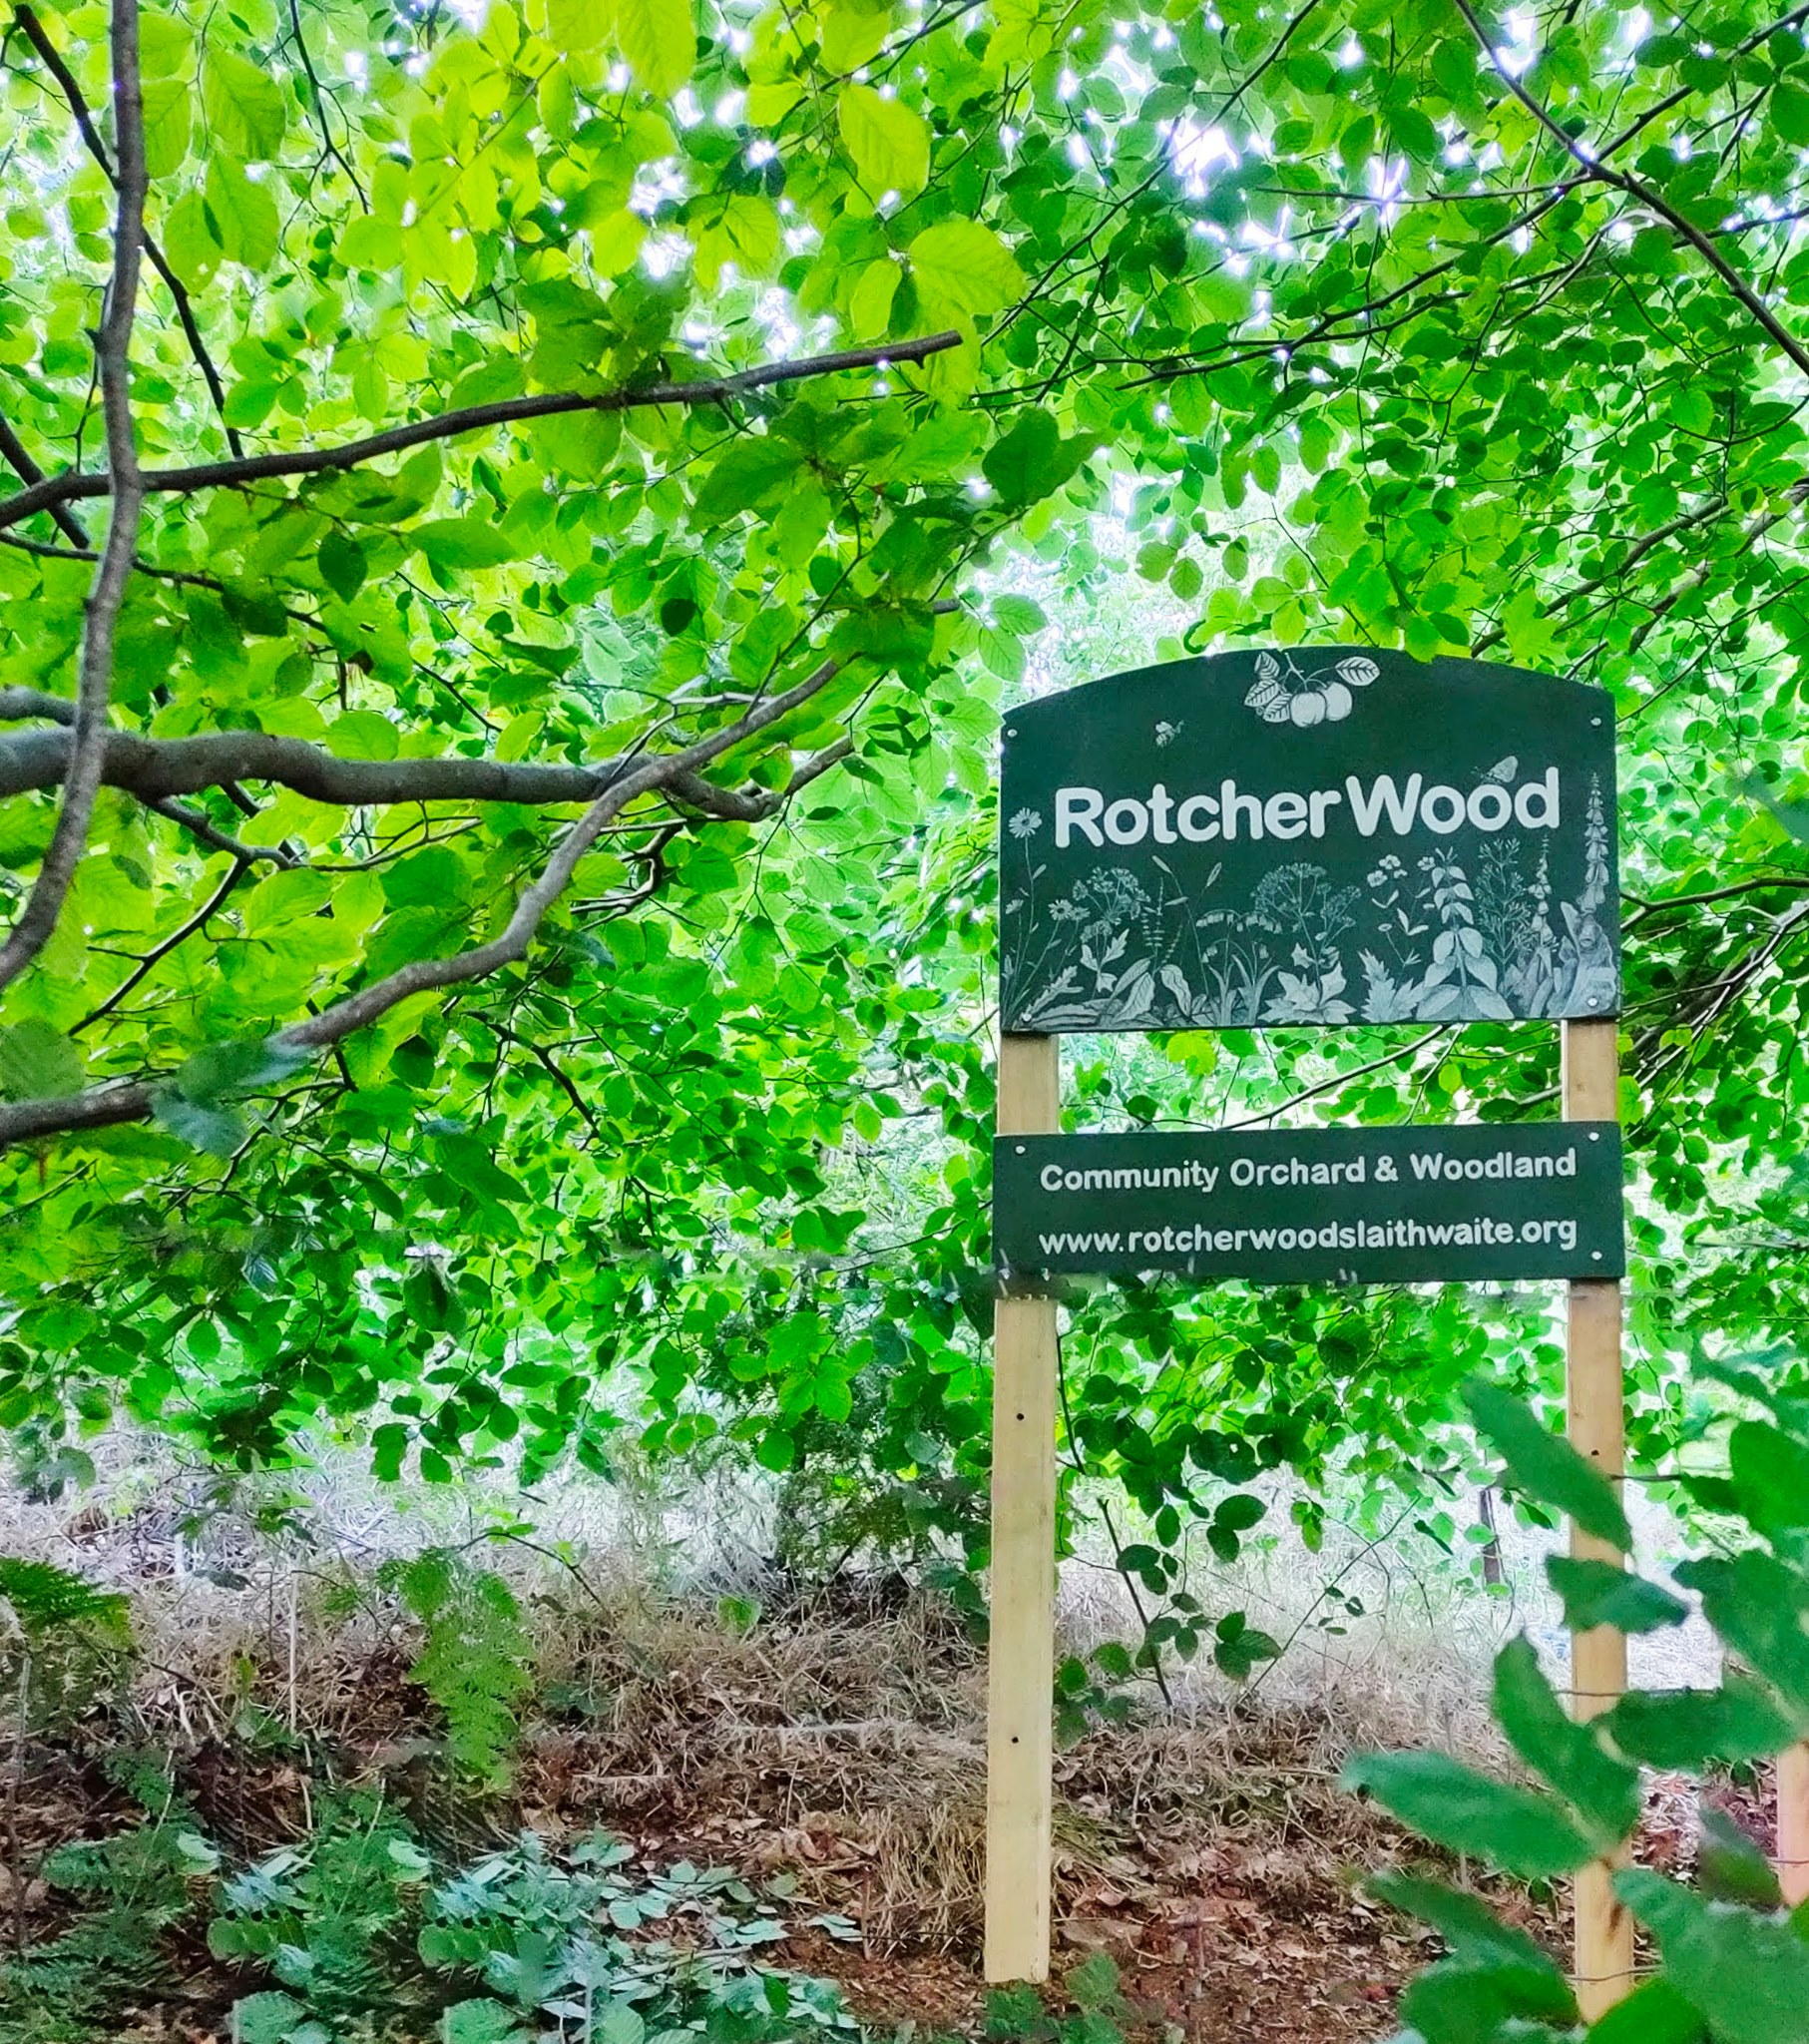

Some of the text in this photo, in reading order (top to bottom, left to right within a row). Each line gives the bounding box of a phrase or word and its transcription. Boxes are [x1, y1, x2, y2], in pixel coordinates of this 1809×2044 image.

[1055, 766, 1561, 848] Rotcher Wood
[1040, 1148, 1578, 1193] Community Orchard & Woodland
[1039, 1218, 1579, 1256] www.rotcherwoodslaithwaite.org
